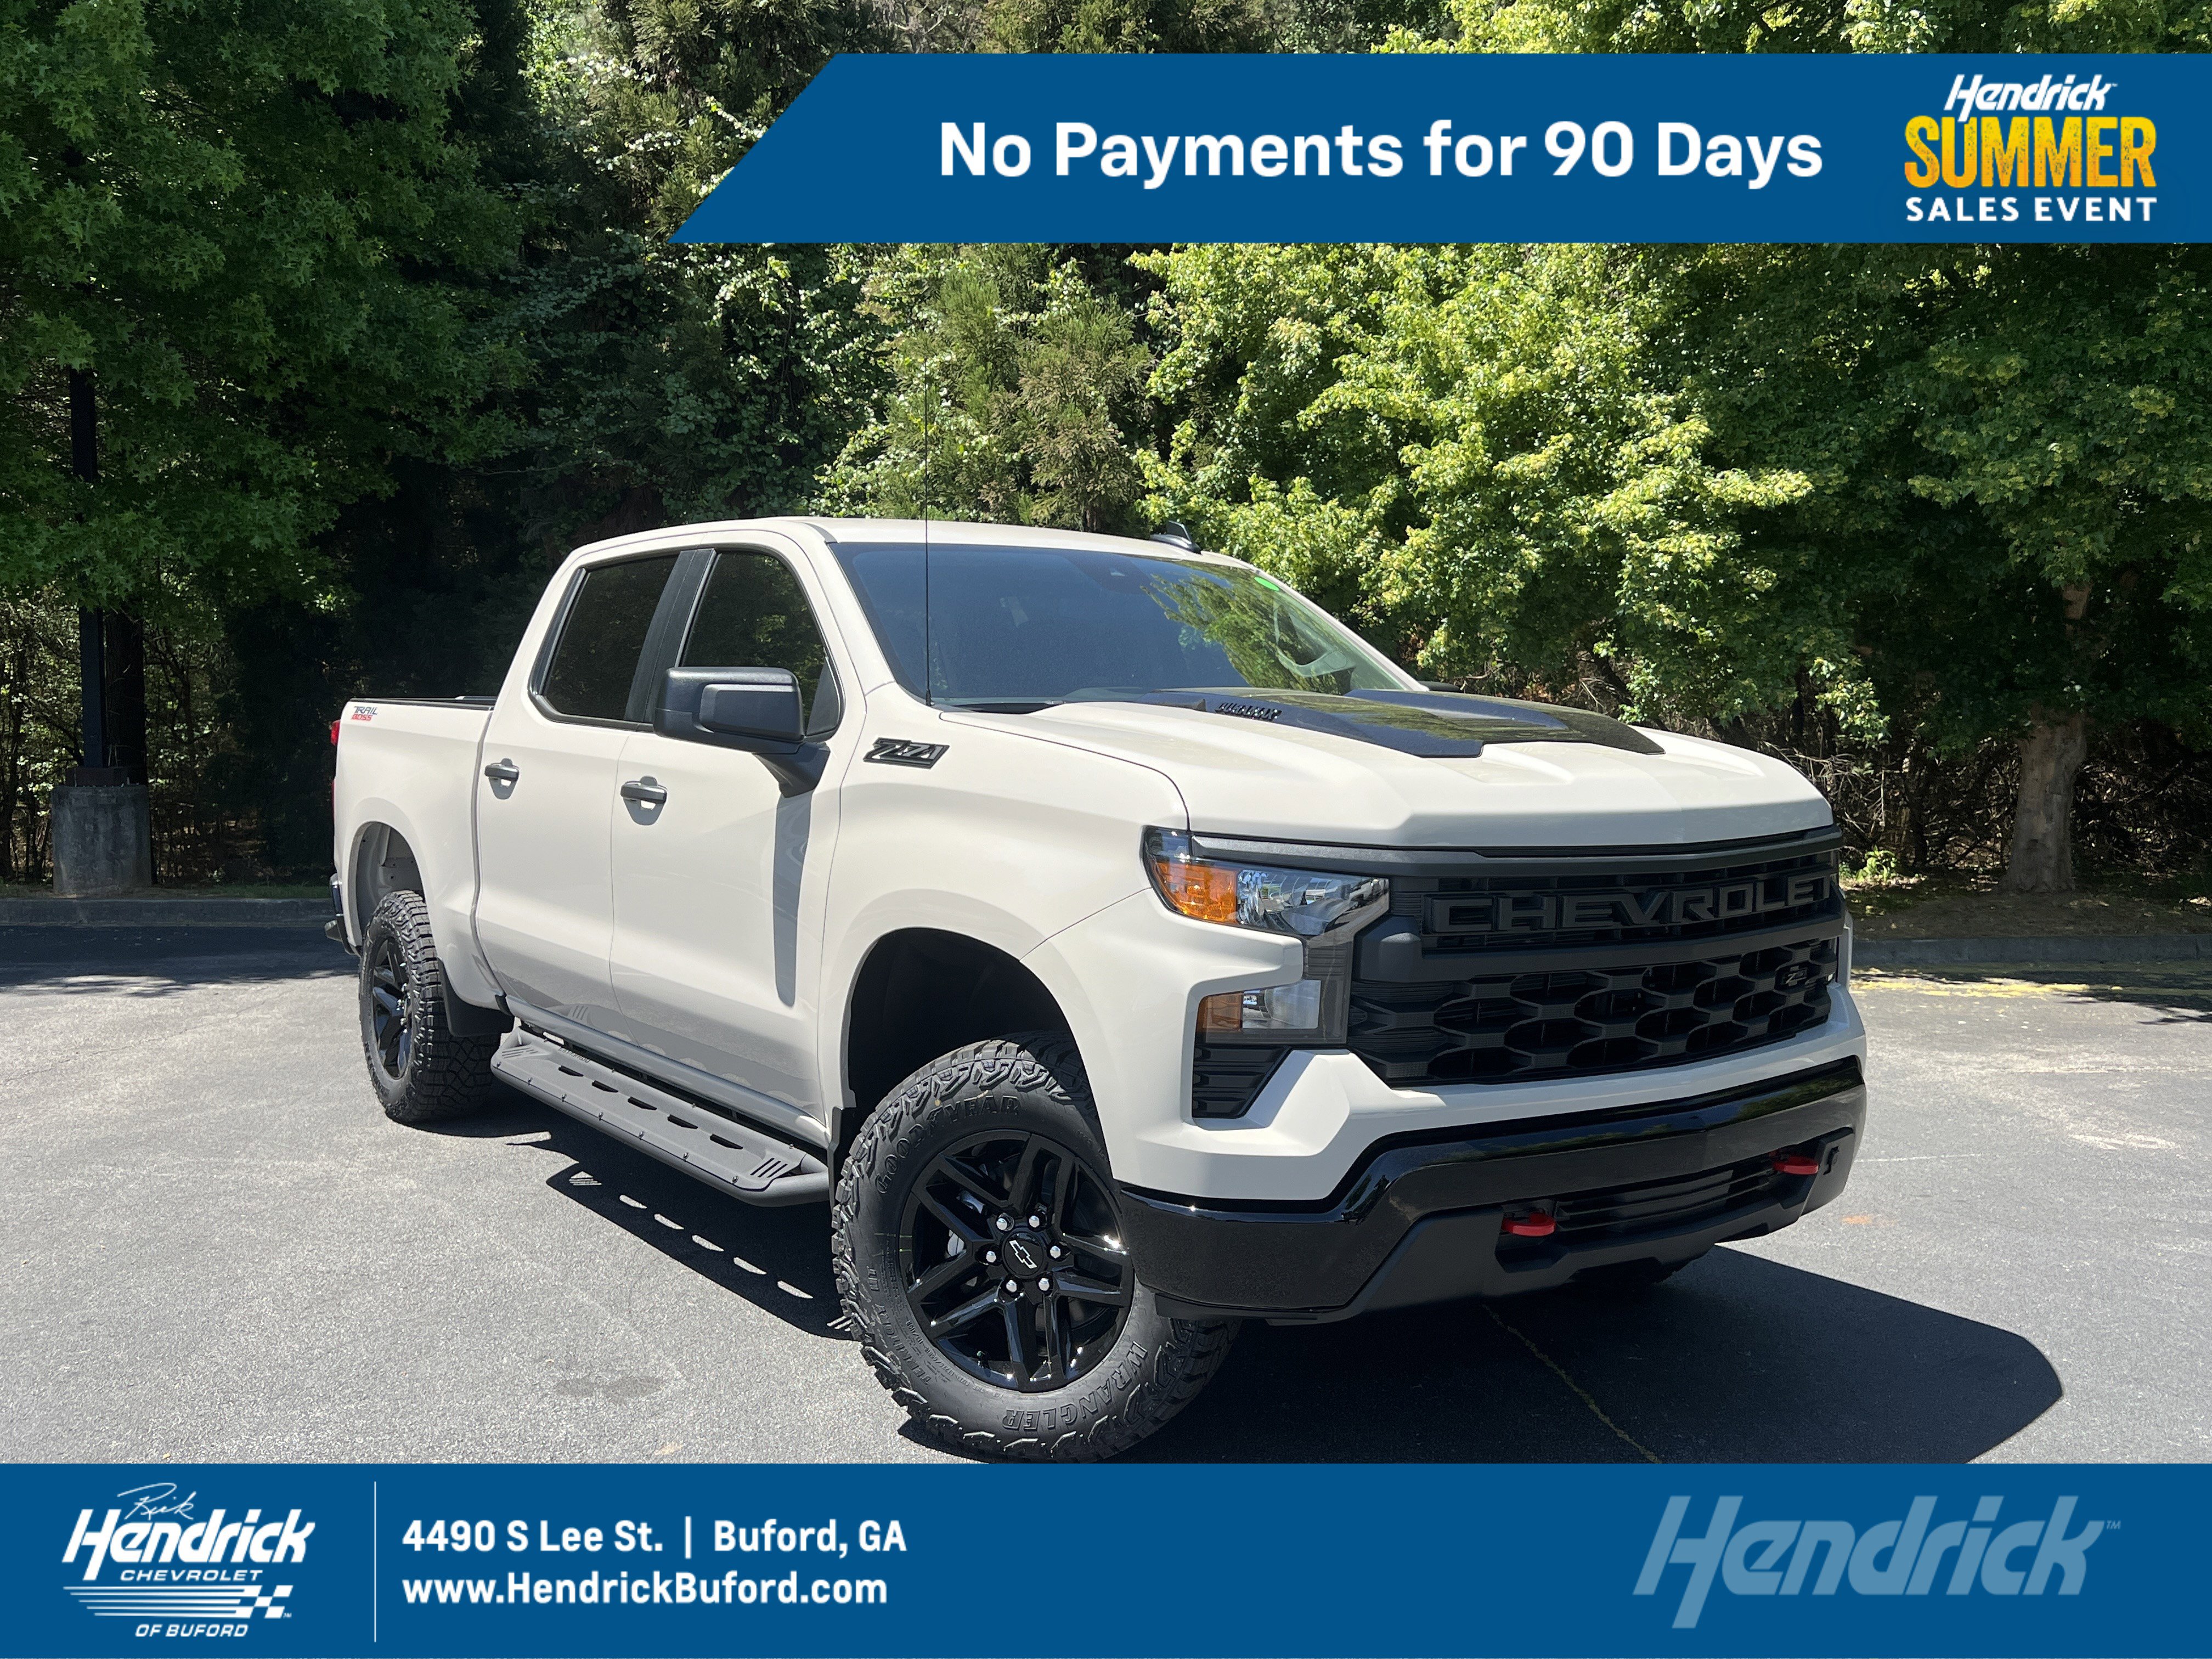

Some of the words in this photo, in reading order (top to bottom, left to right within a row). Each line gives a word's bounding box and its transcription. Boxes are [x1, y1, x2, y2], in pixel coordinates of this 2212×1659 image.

[354, 706, 377, 715] TRAIL
[1430, 871, 1831, 933] CHEVROLET
[1002, 1340, 1148, 1431] WRANGLER
